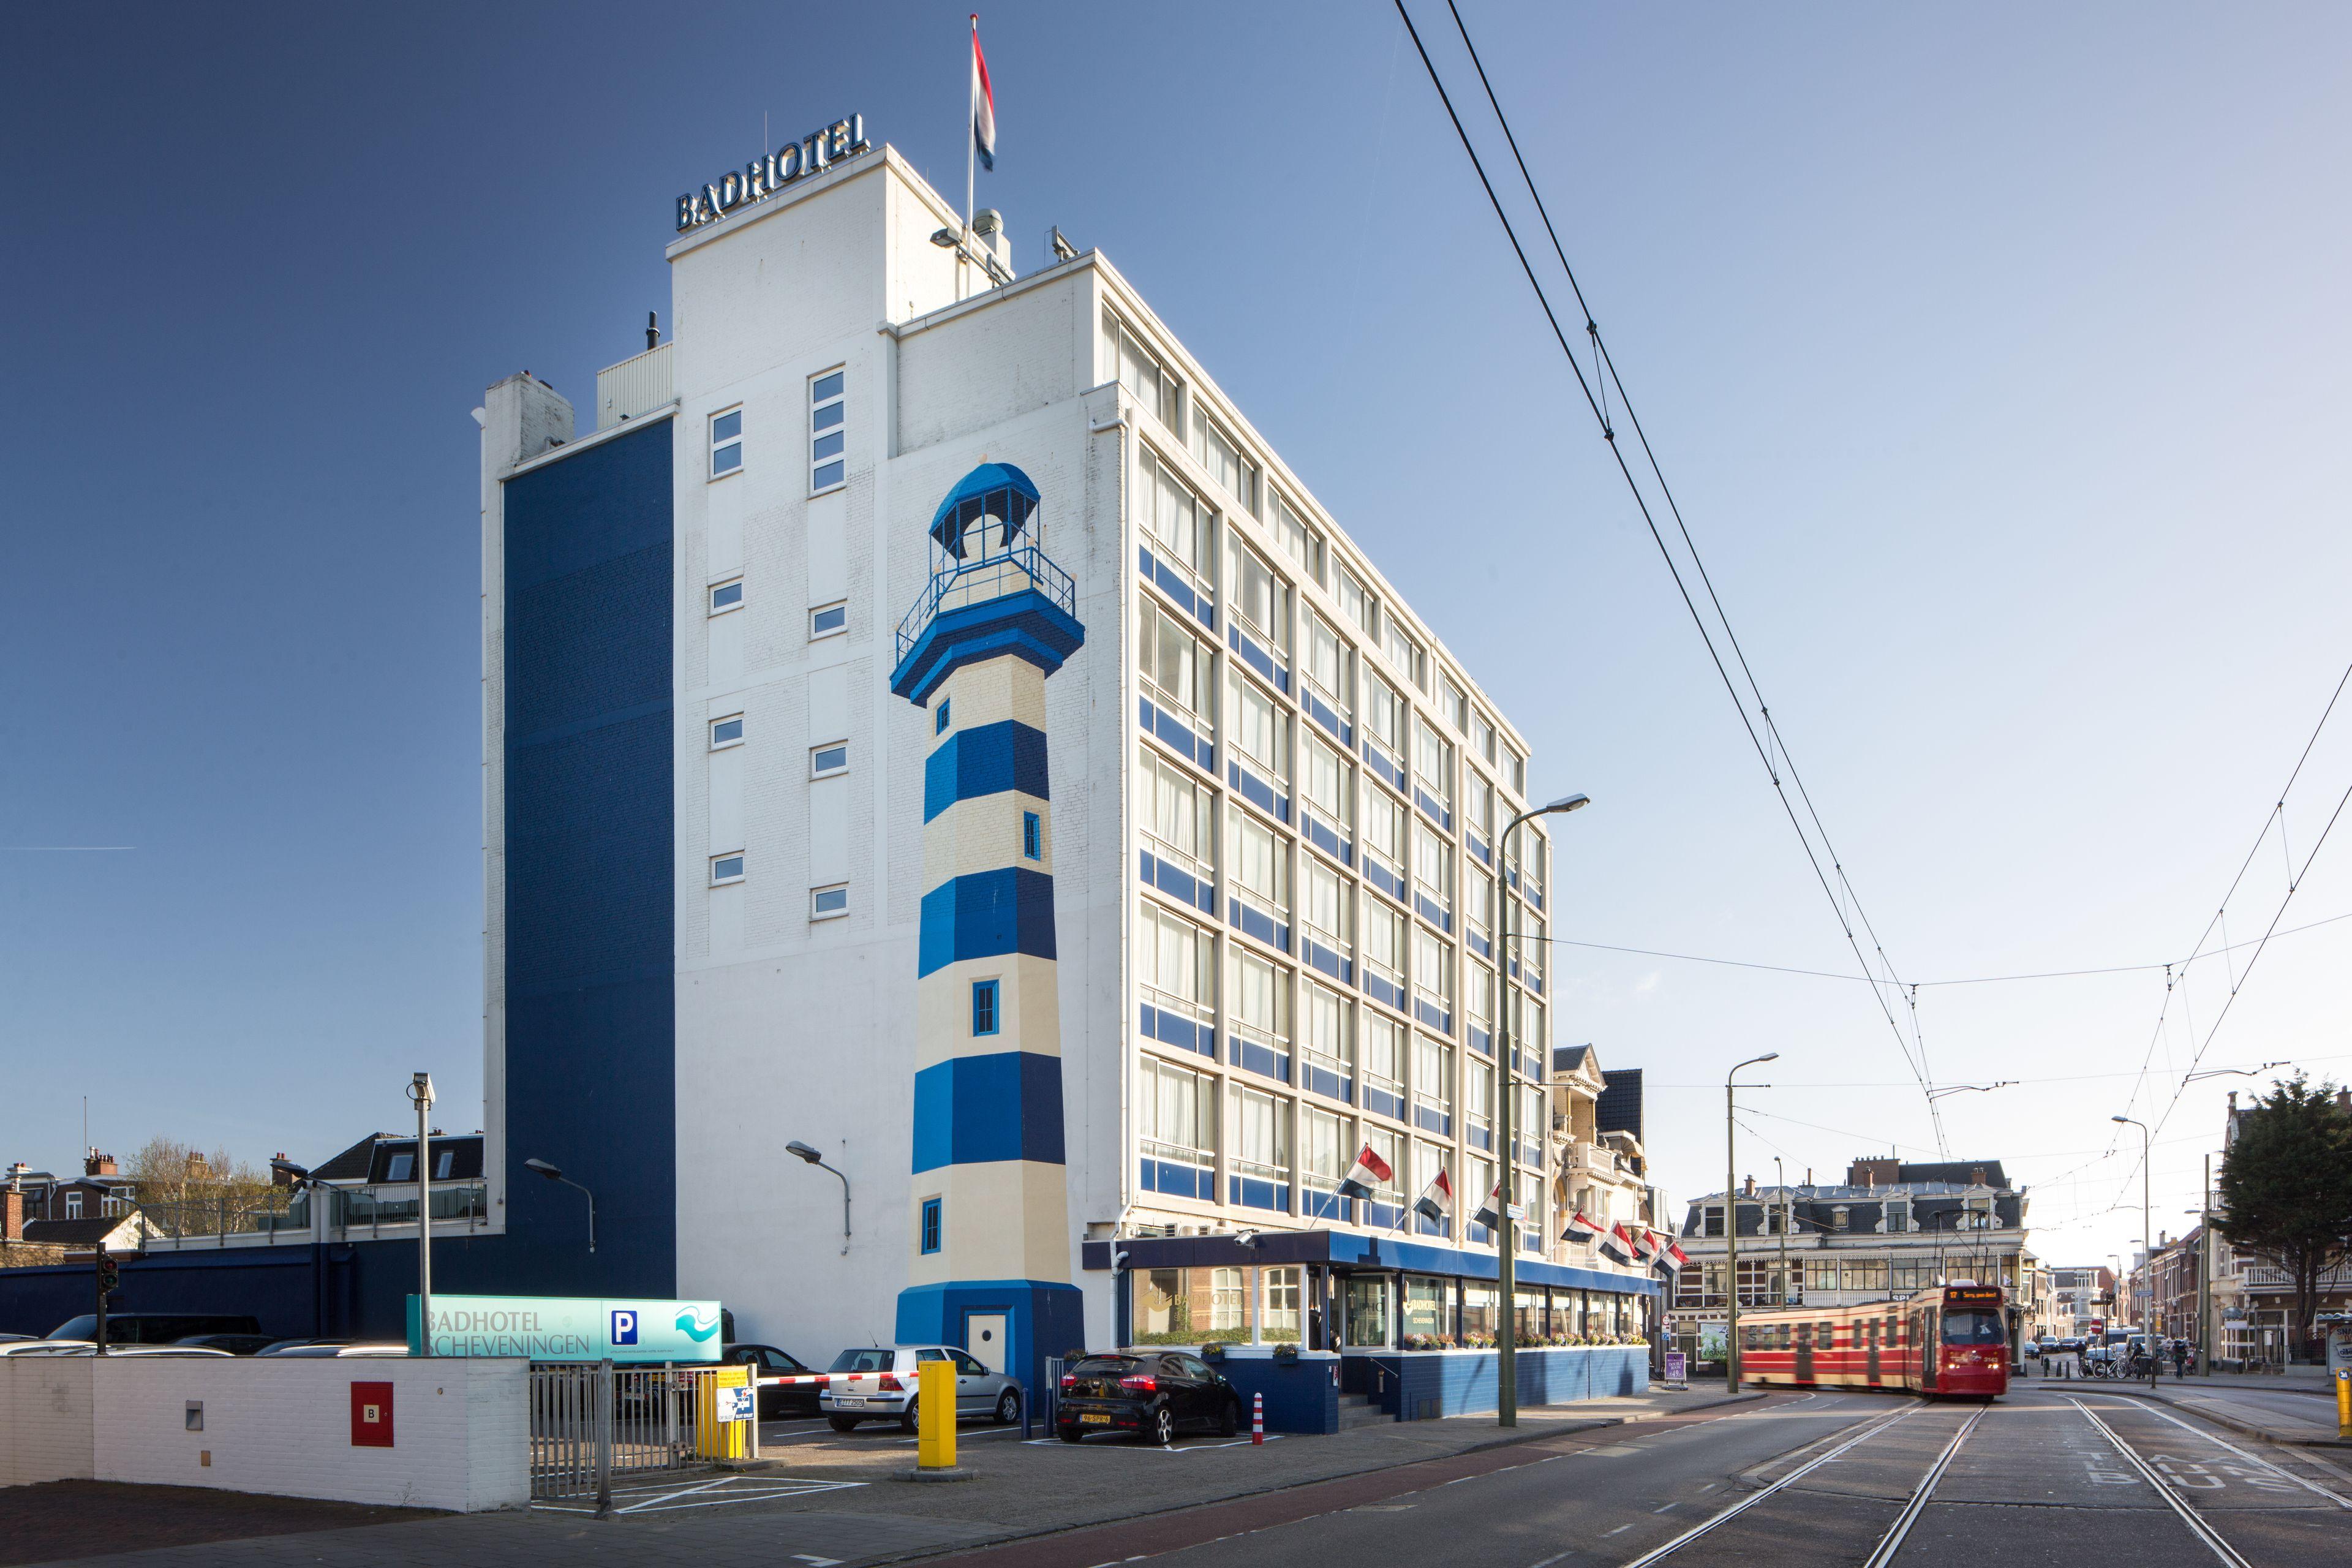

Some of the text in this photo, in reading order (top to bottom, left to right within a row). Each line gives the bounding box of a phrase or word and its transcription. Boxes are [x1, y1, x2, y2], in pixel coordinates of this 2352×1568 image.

[676, 113, 870, 234] BADHOTEL
[1174, 1293, 1243, 1306] BADHOTEL
[1412, 1299, 1436, 1311] BADHOTEL
[616, 1312, 633, 1343] P
[368, 1409, 375, 1419] B
[2087, 1471, 2302, 1491] BUS
